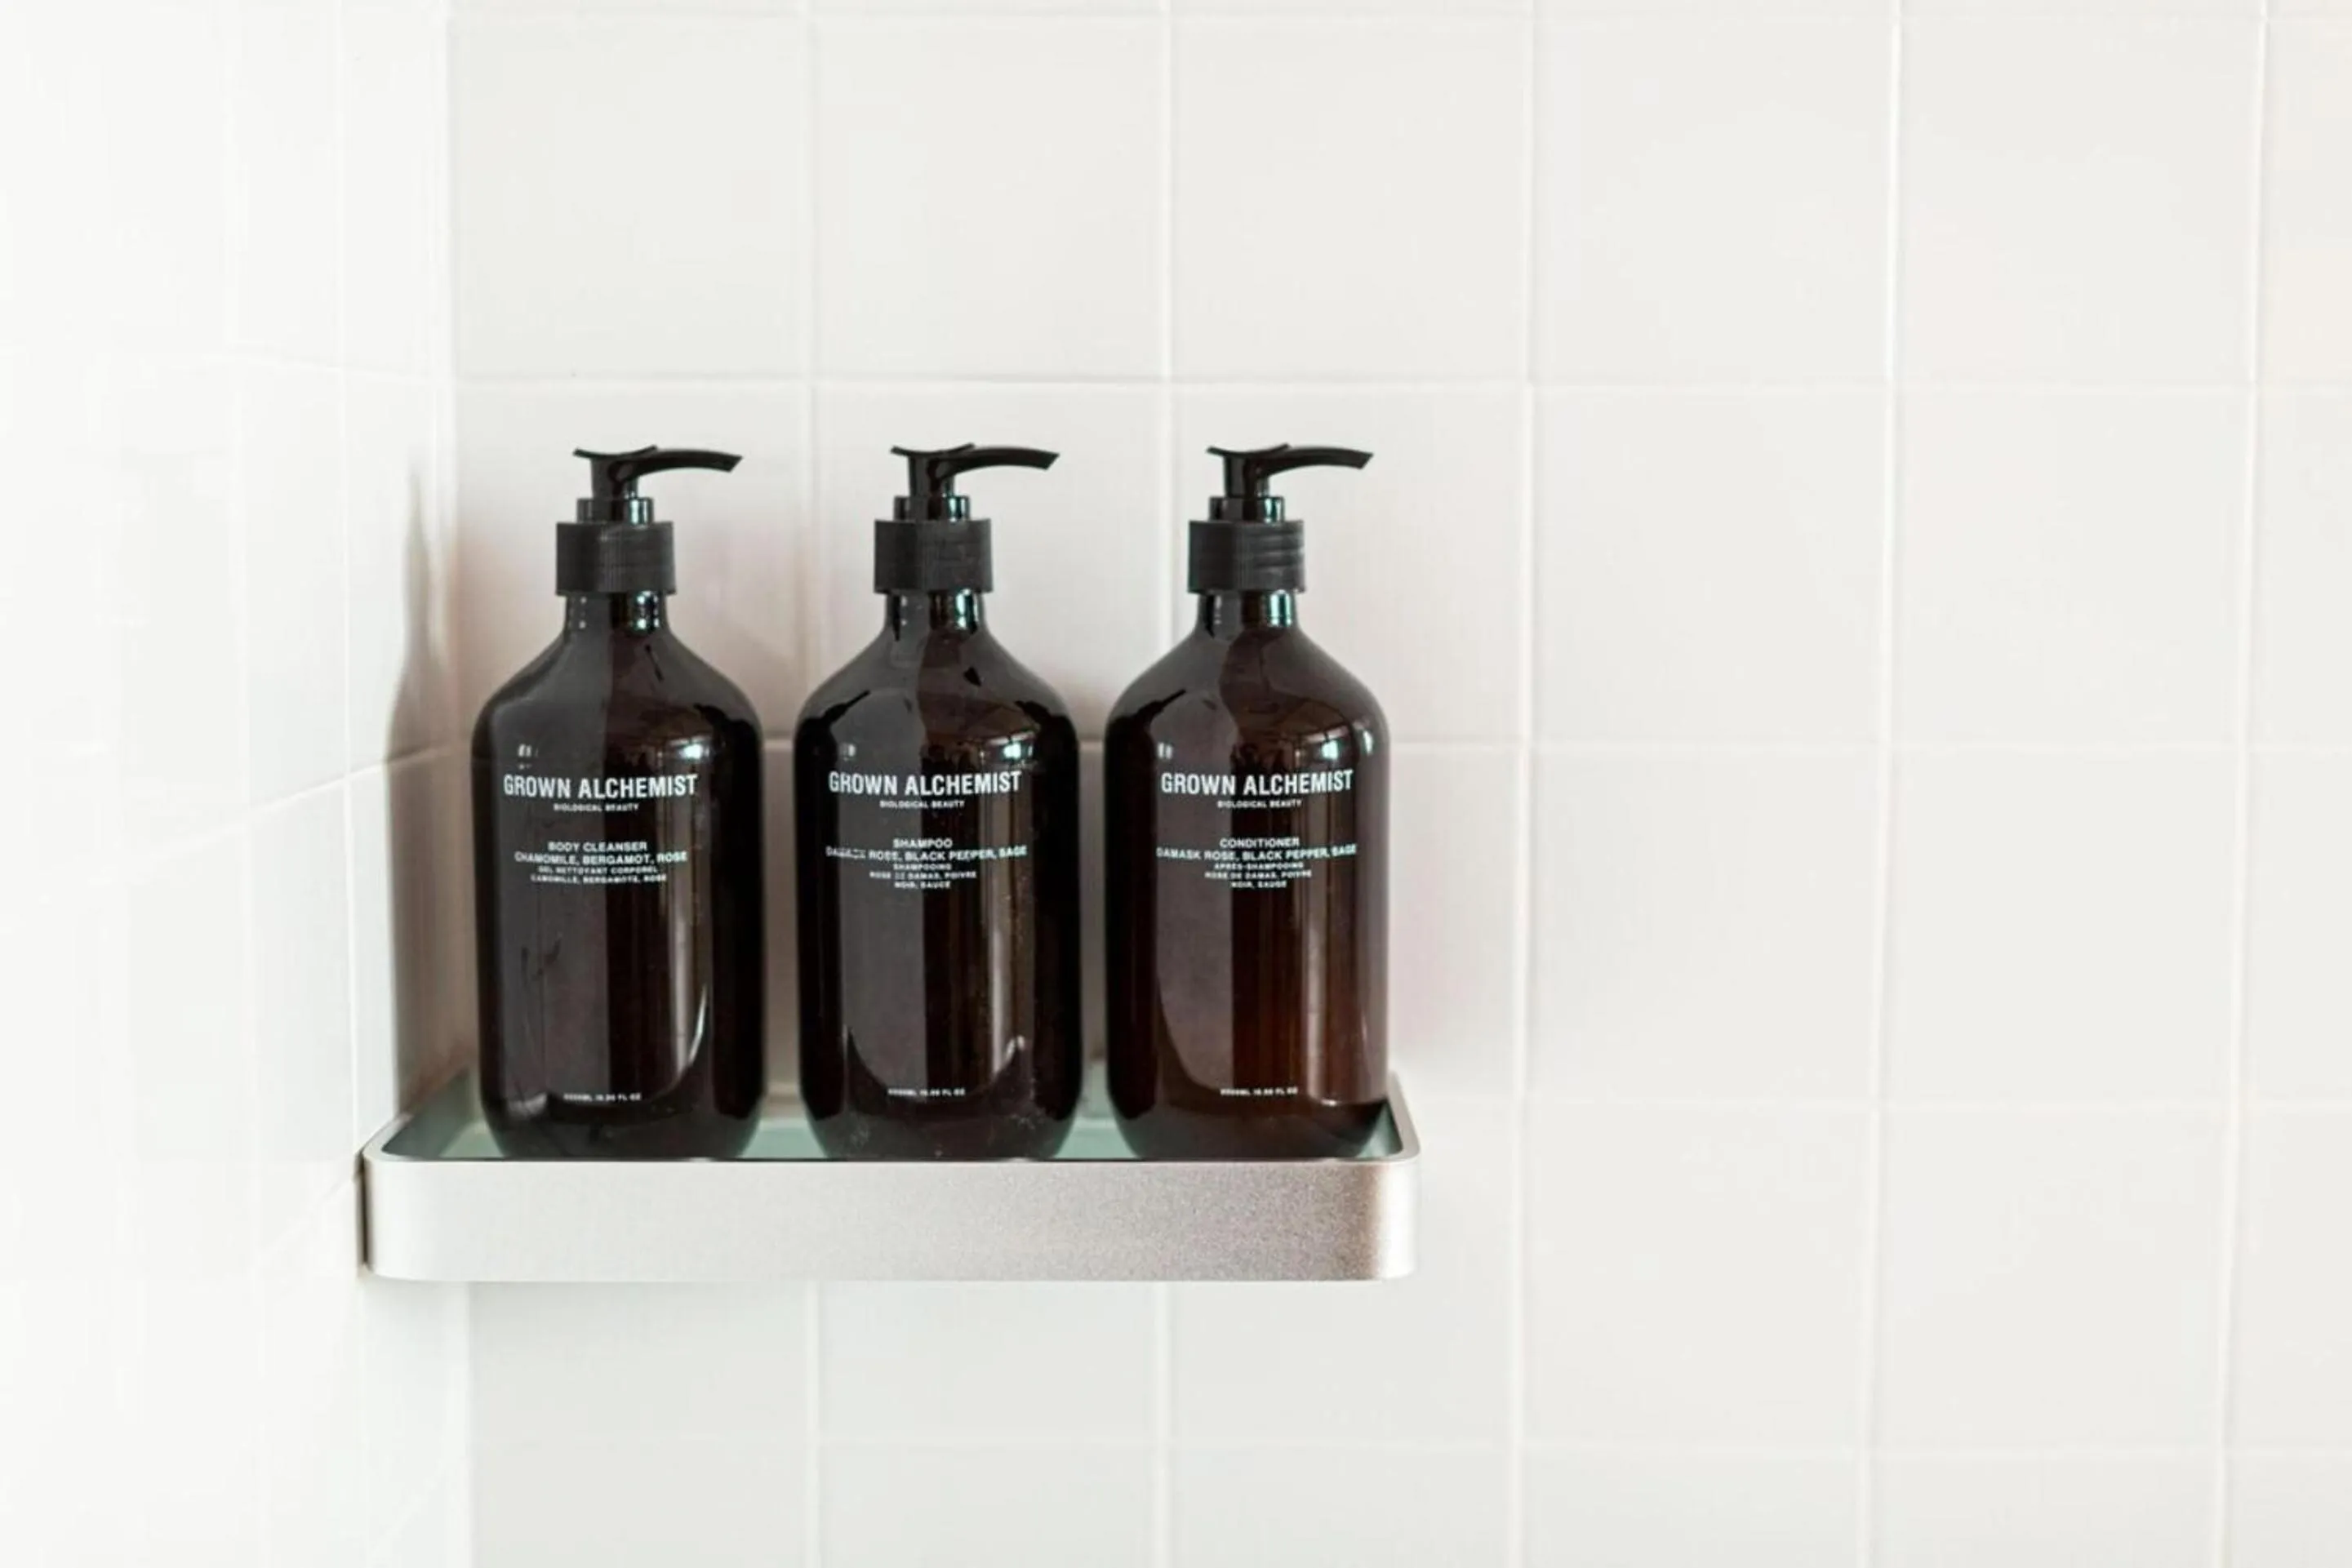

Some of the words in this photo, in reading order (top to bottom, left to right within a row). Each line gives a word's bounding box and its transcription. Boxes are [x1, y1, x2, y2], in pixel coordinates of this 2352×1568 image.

[504, 774, 571, 798] GROWN
[578, 774, 698, 798] ALCHEMIST
[829, 771, 897, 795] GROWN
[905, 771, 1022, 796] ALCHEMIST
[1161, 772, 1235, 794] GROWN
[1243, 769, 1354, 795] ALCHEMIST
[554, 803, 602, 811] BIOLOGICAL
[605, 803, 639, 811] BEAUTY
[879, 800, 928, 808] BIOLOGICAL
[931, 800, 965, 808] BEAUTY
[1217, 800, 1267, 809] BIOLOGICAL
[1269, 800, 1302, 808] BEAUTY
[549, 842, 580, 851] BODY
[583, 842, 647, 852] CLEANSER
[893, 838, 953, 849] SHAMPOO
[1220, 837, 1300, 848] CONDITIONER
[656, 851, 687, 863] ROSE
[905, 851, 945, 861] BLACK
[998, 846, 1028, 858] SAGE
[1156, 846, 1202, 860] DAMASK
[1243, 851, 1282, 861] BLACK
[1331, 843, 1358, 857] SAGE
